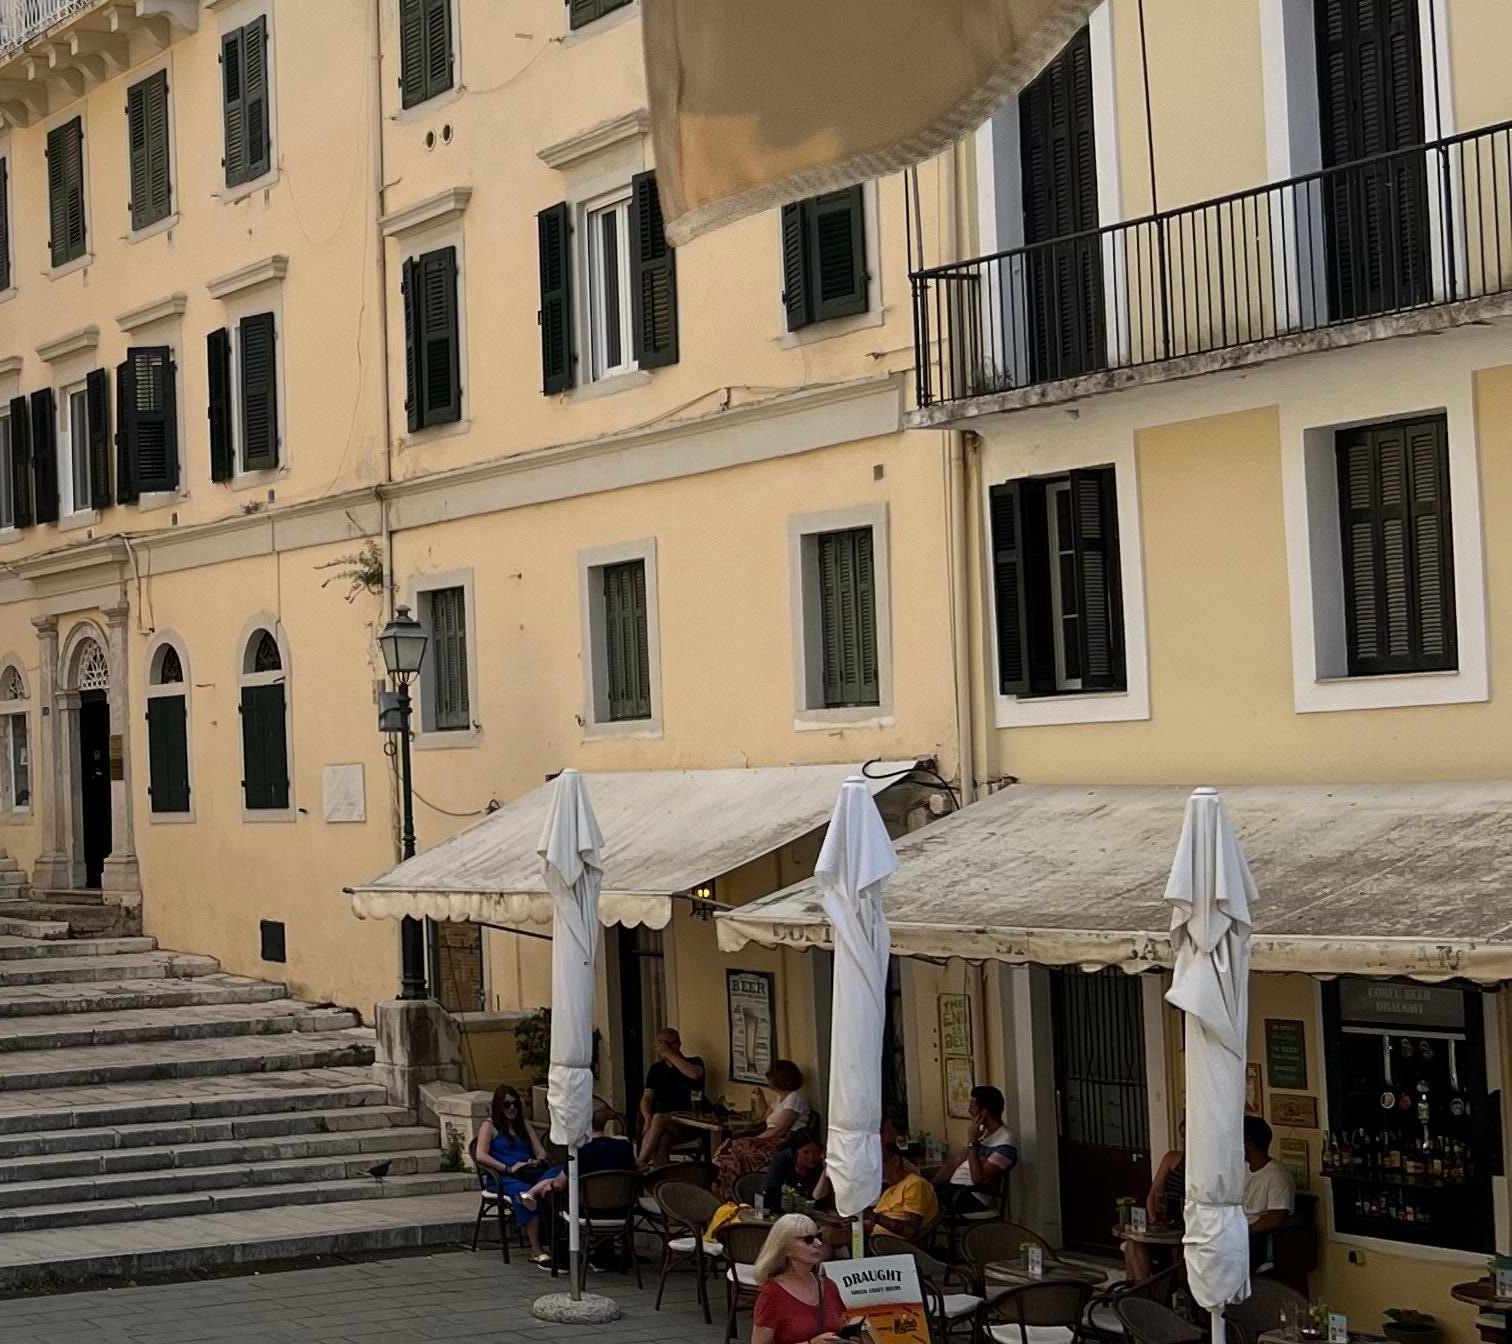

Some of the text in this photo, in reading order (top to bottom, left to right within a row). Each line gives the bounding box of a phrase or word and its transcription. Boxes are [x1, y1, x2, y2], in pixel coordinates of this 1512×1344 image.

[731, 979, 766, 994] BEER
[1367, 986, 1432, 1001] CORFU BEER
[843, 1269, 903, 1288] DRAUGHT
